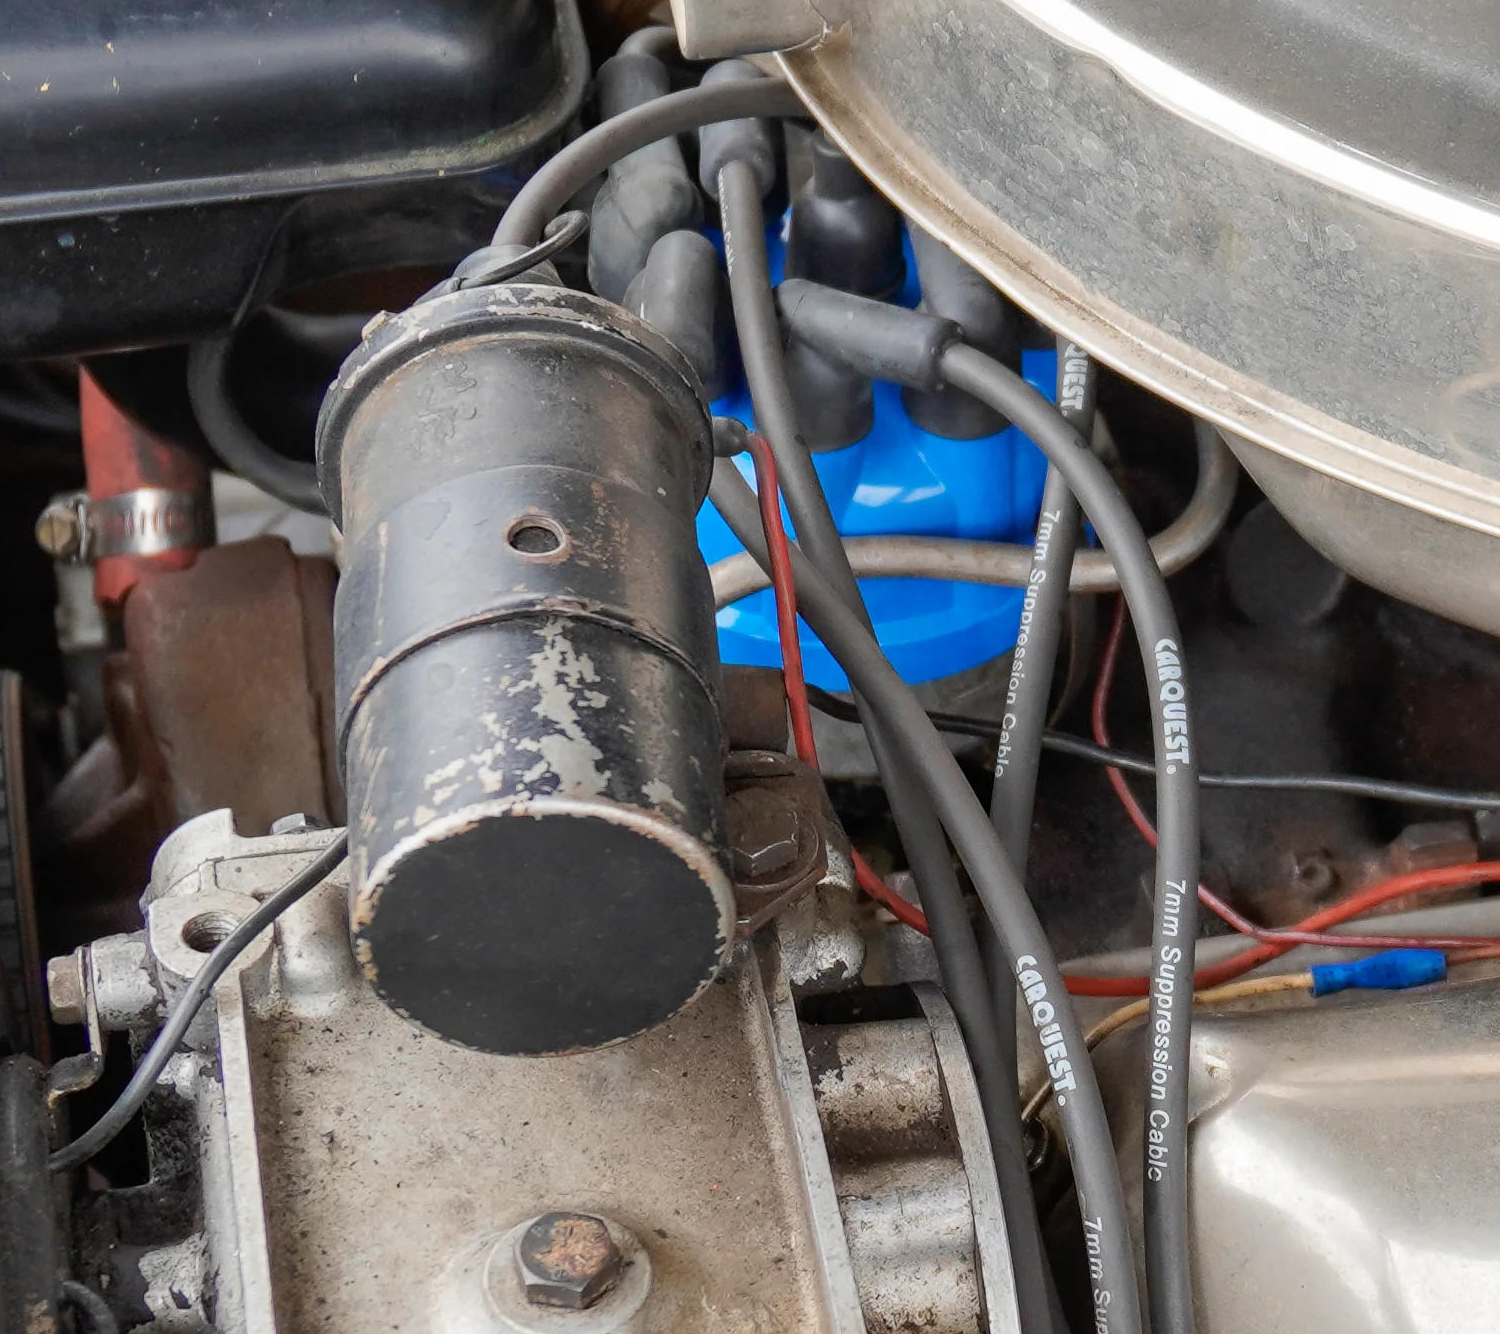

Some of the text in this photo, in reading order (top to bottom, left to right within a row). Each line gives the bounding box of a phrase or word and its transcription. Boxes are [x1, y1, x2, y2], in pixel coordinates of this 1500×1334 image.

[1033, 509, 1061, 562] 7mm
[1005, 567, 1048, 706] Suppression
[993, 712, 1018, 780] Cable
[1161, 879, 1187, 937] 7mm
[1151, 944, 1183, 1101] Suppression
[1147, 1109, 1171, 1183] Cable
[1084, 1216, 1104, 1280] 7mm
